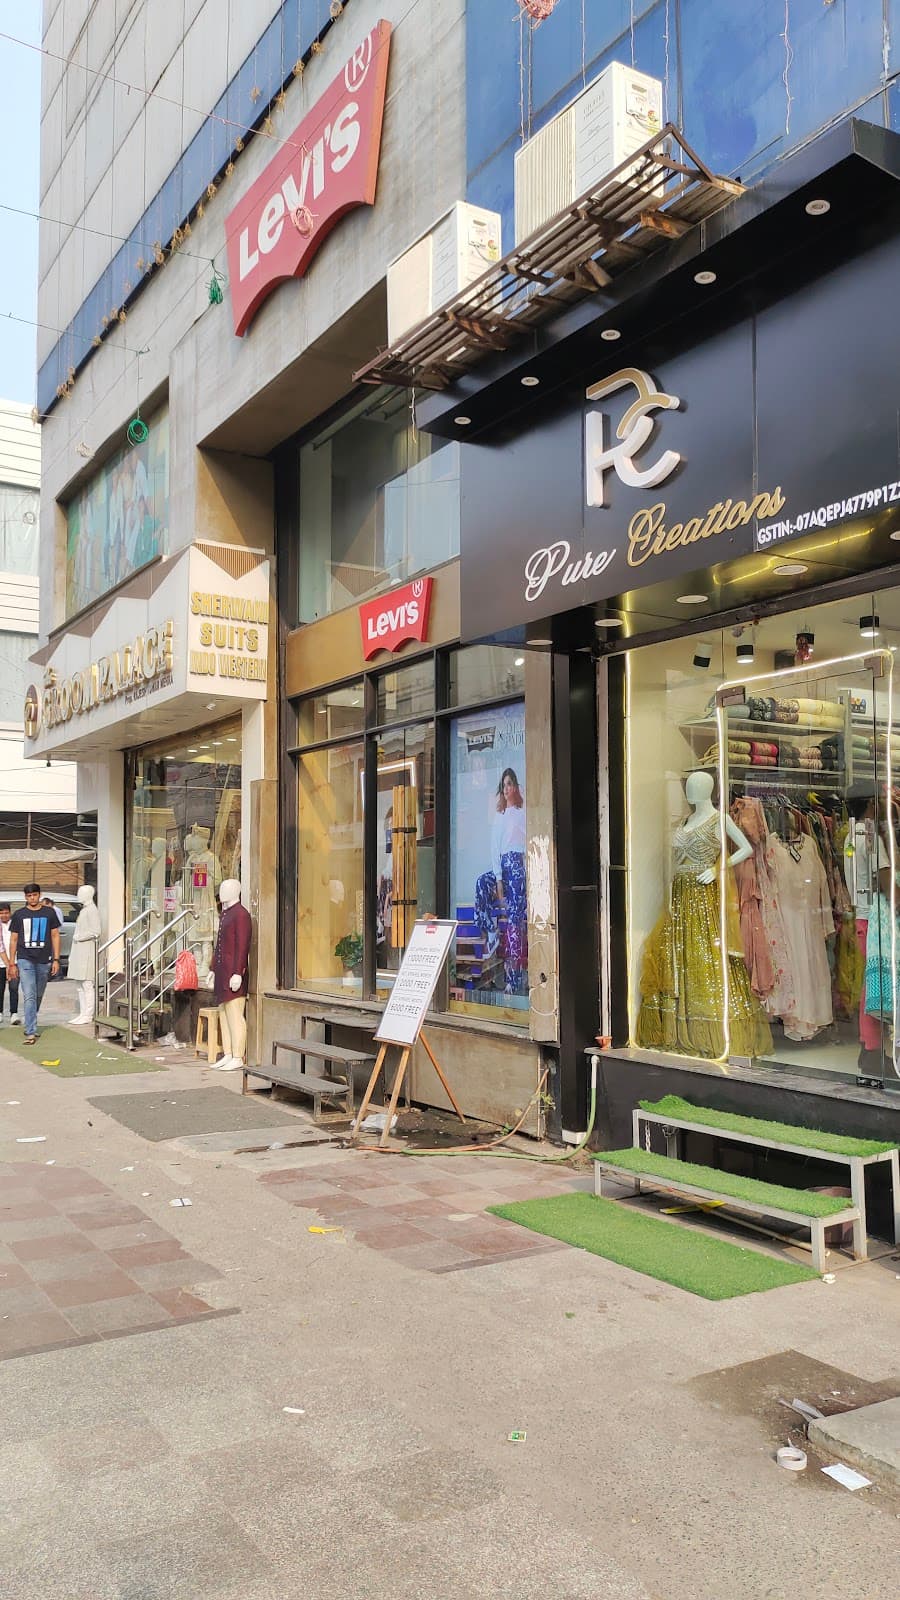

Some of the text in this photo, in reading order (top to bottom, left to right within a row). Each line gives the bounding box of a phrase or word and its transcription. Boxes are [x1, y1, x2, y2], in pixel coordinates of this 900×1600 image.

[525, 486, 786, 602] Pure Creations
[98, 619, 174, 702] PALACE
[201, 622, 259, 652] SUITS
[190, 651, 267, 683] INDO WESTERN
